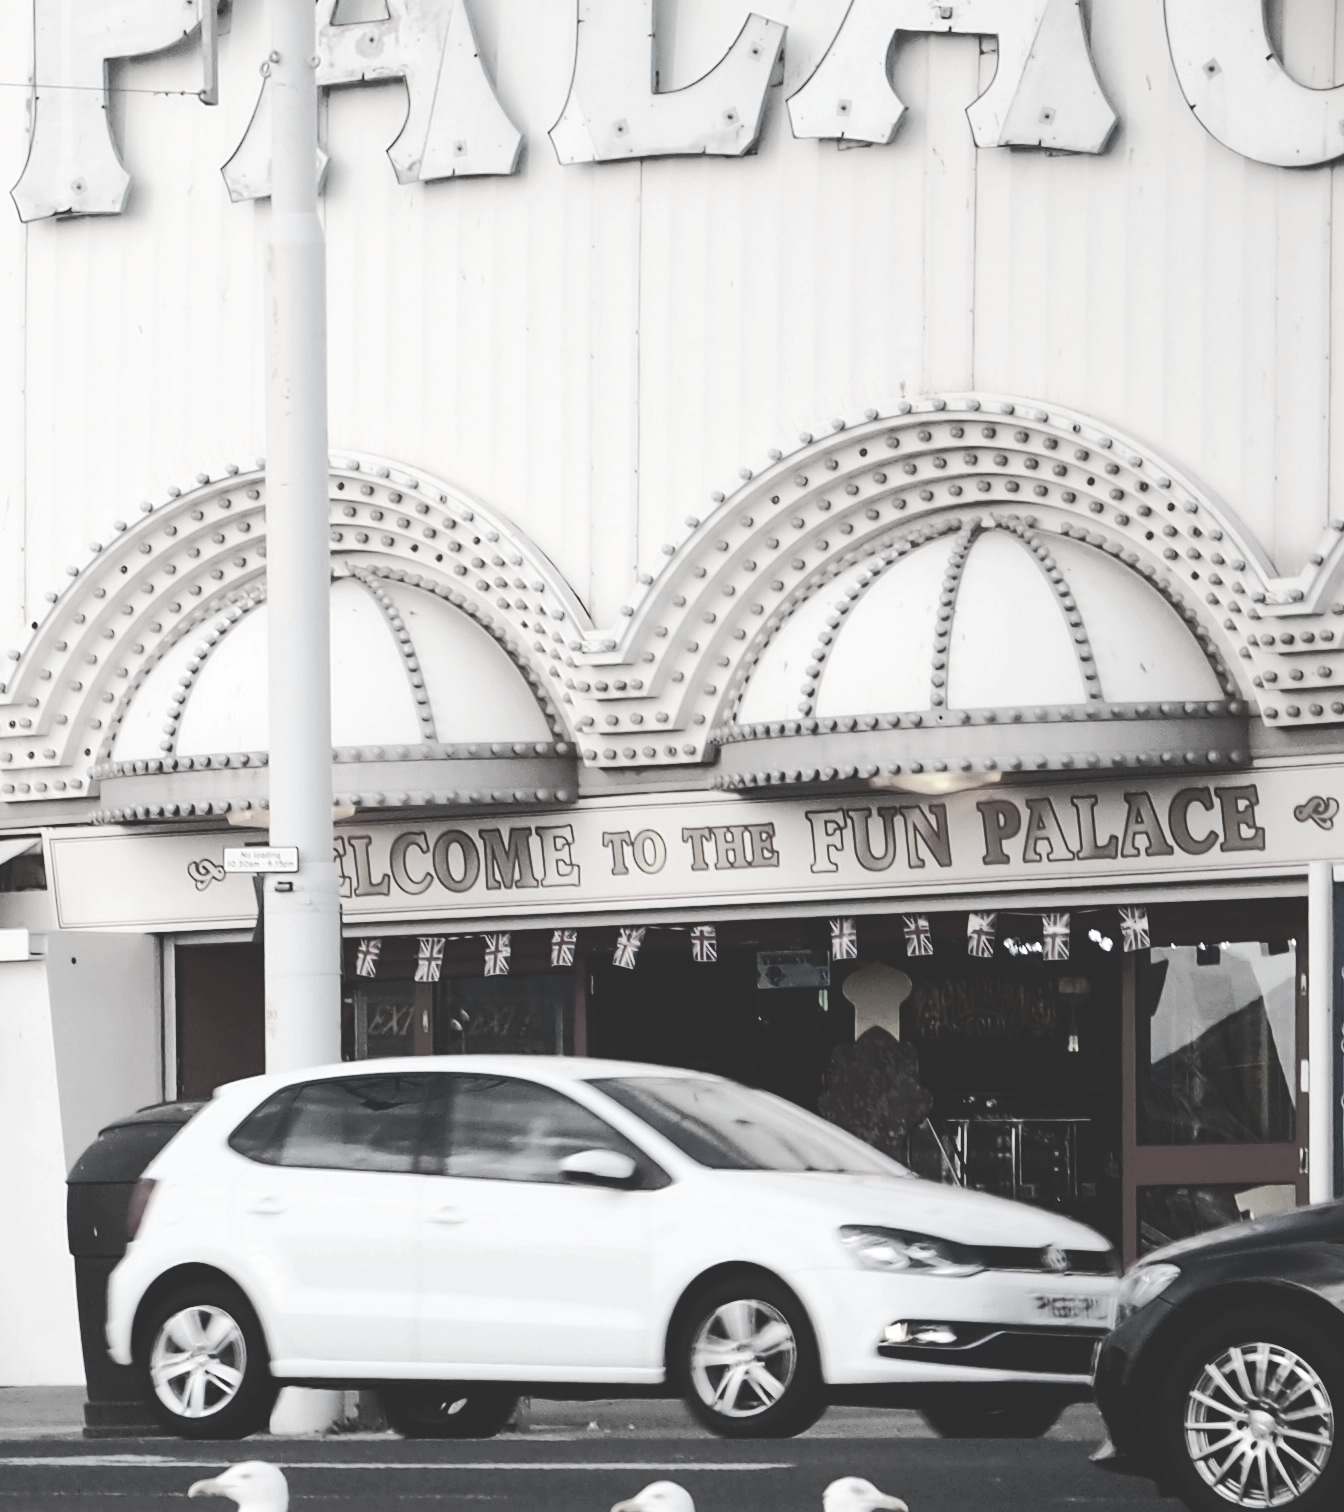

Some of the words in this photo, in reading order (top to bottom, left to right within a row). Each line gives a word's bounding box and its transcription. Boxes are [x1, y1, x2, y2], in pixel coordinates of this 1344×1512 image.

[332, 824, 581, 898] LCOME
[602, 828, 667, 875] TO
[682, 822, 780, 871] THE
[805, 803, 952, 873] FUN
[976, 784, 1266, 866] PALACE
